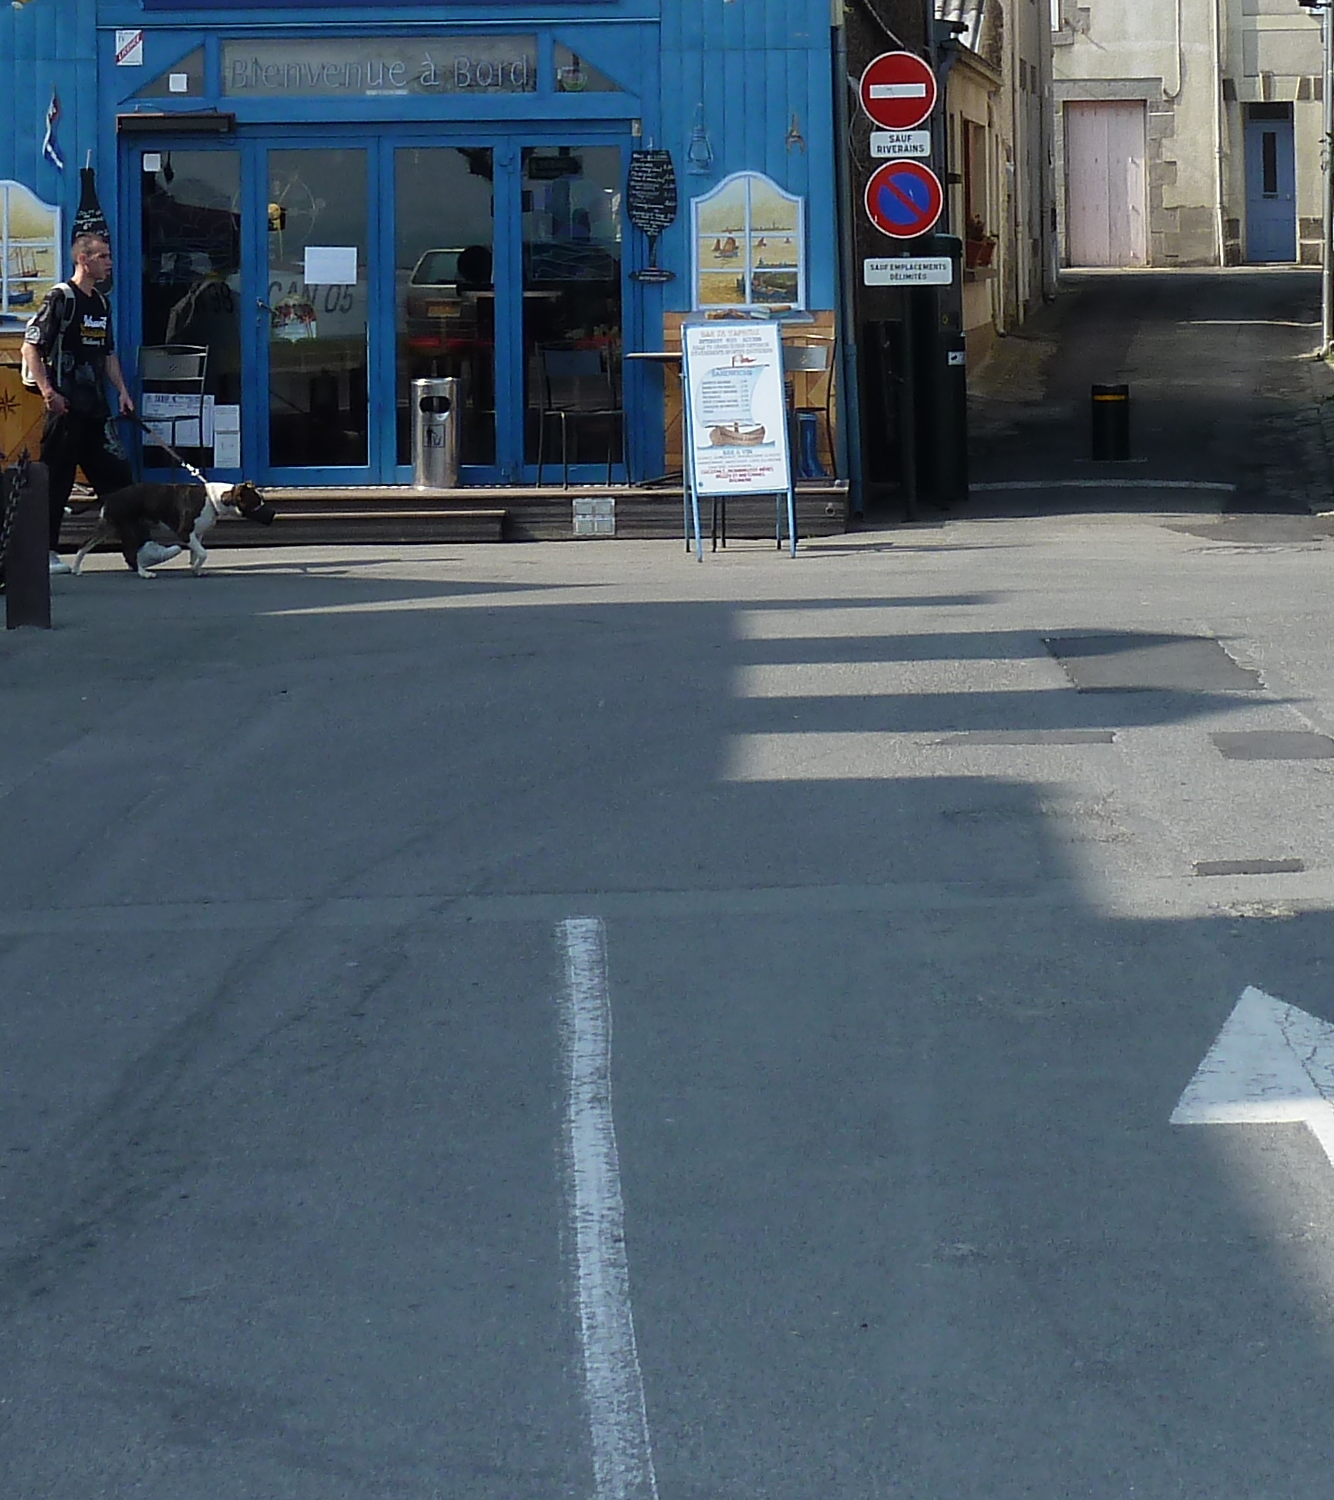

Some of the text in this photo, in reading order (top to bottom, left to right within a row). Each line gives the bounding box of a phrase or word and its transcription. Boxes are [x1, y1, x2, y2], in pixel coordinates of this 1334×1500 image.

[229, 52, 528, 89] Bienvenue à Bord
[888, 134, 913, 144] SAUF
[876, 144, 925, 155] RIVERAINS
[870, 263, 948, 272] SAUF EMPLACEMENTS
